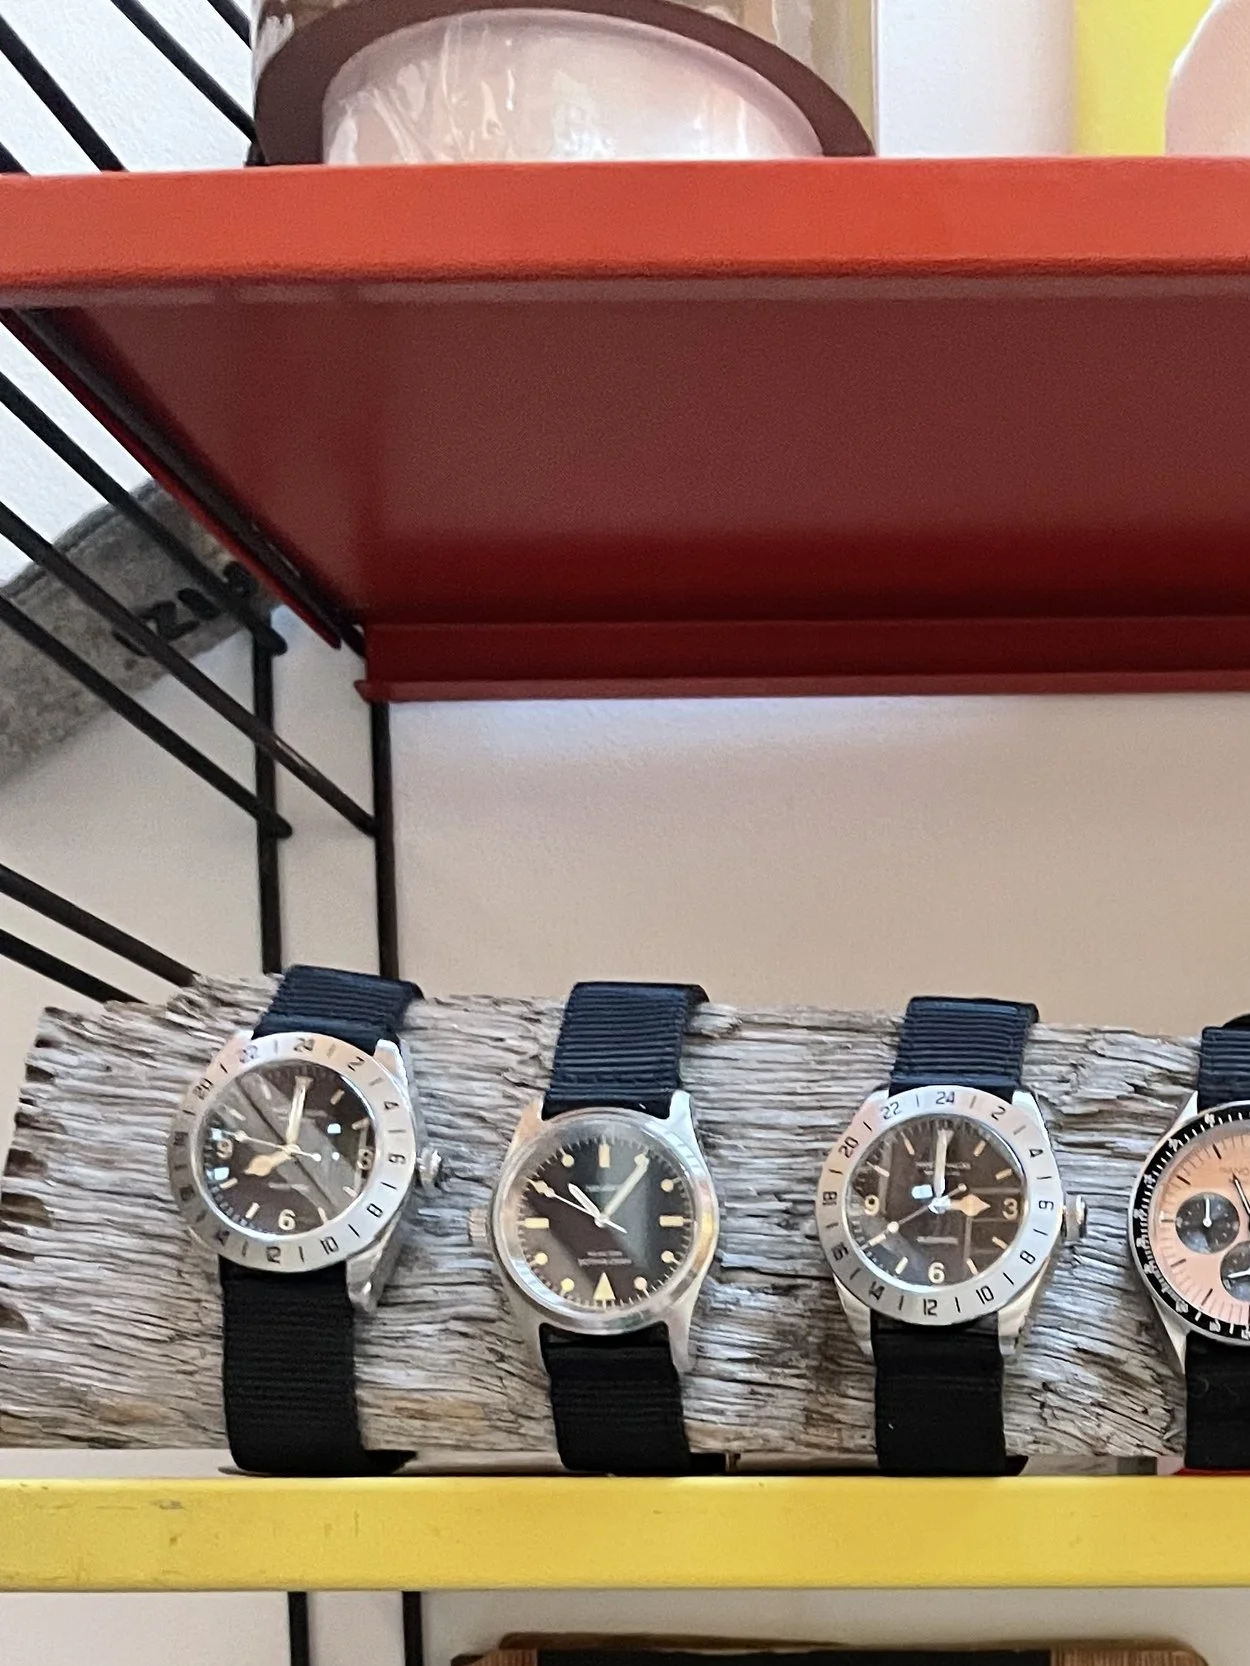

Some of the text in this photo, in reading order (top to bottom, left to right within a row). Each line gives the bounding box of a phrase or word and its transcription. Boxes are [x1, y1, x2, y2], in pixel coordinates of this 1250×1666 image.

[864, 1194, 880, 1216] 9
[278, 1208, 296, 1231] 6
[928, 1262, 946, 1284] 6
[975, 1284, 995, 1304] 10
[923, 1298, 938, 1316] 12
